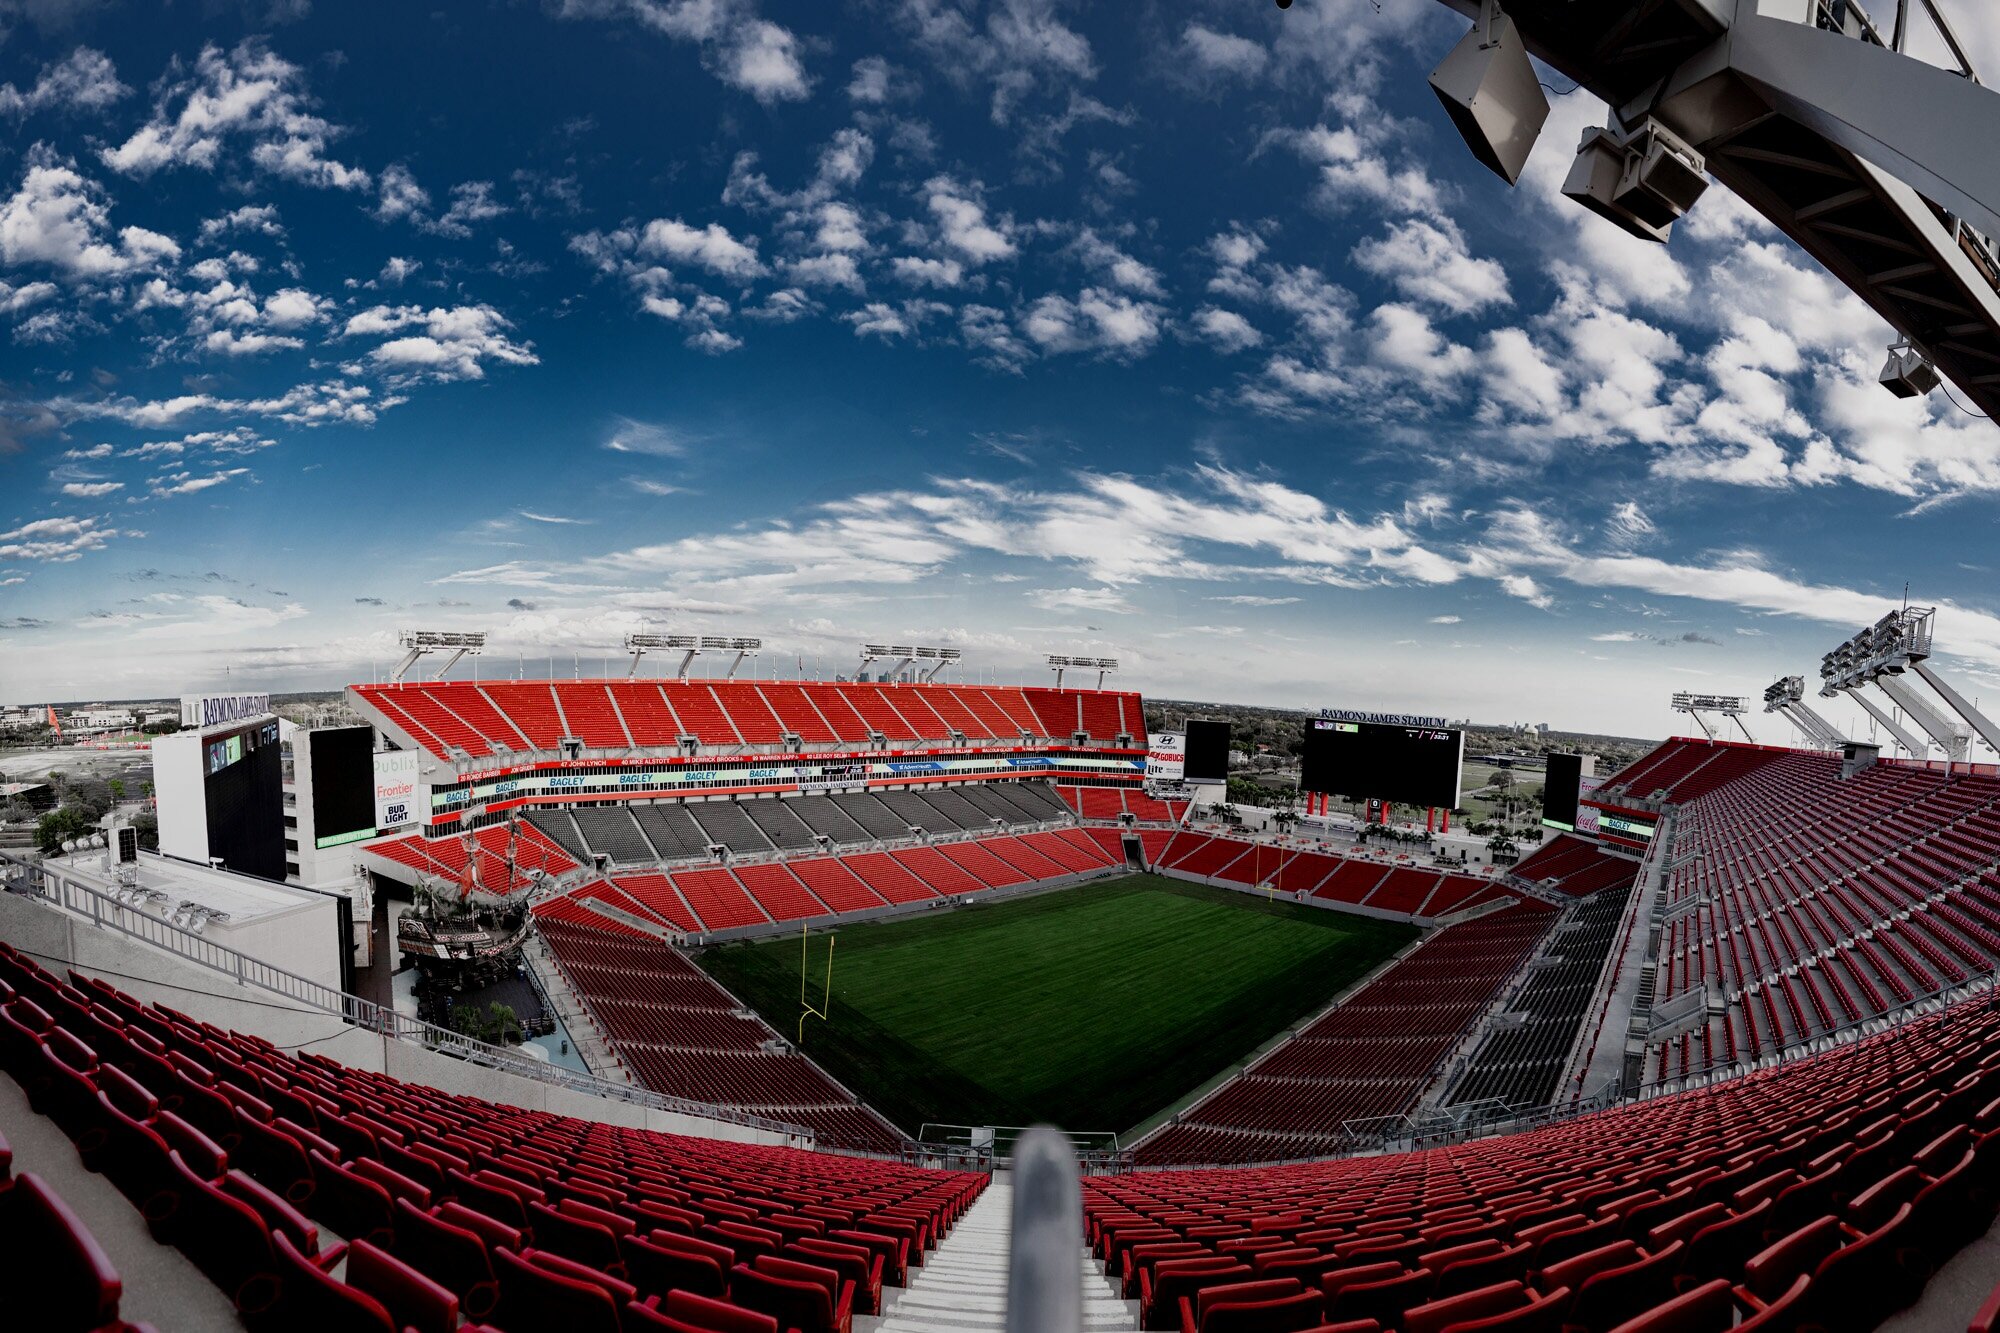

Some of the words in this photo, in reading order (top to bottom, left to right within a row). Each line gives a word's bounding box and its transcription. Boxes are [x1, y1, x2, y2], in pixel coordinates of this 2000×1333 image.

[202, 697, 238, 728] RAYMOND
[1321, 708, 1366, 720] RAYMOND
[1367, 713, 1400, 724] JAMES
[1401, 715, 1447, 727] STADIUM
[685, 771, 717, 780] BAGLEY
[749, 769, 778, 778] BAGLEY
[1147, 764, 1164, 776] Lite
[549, 777, 585, 786] BAGLEY
[620, 774, 653, 783] BAGLEY
[377, 783, 414, 798] Frontier
[495, 781, 519, 793] BAGLEY
[388, 804, 405, 815] BUD
[385, 811, 408, 824] LIGHT
[1608, 819, 1631, 831] BAGLEY
